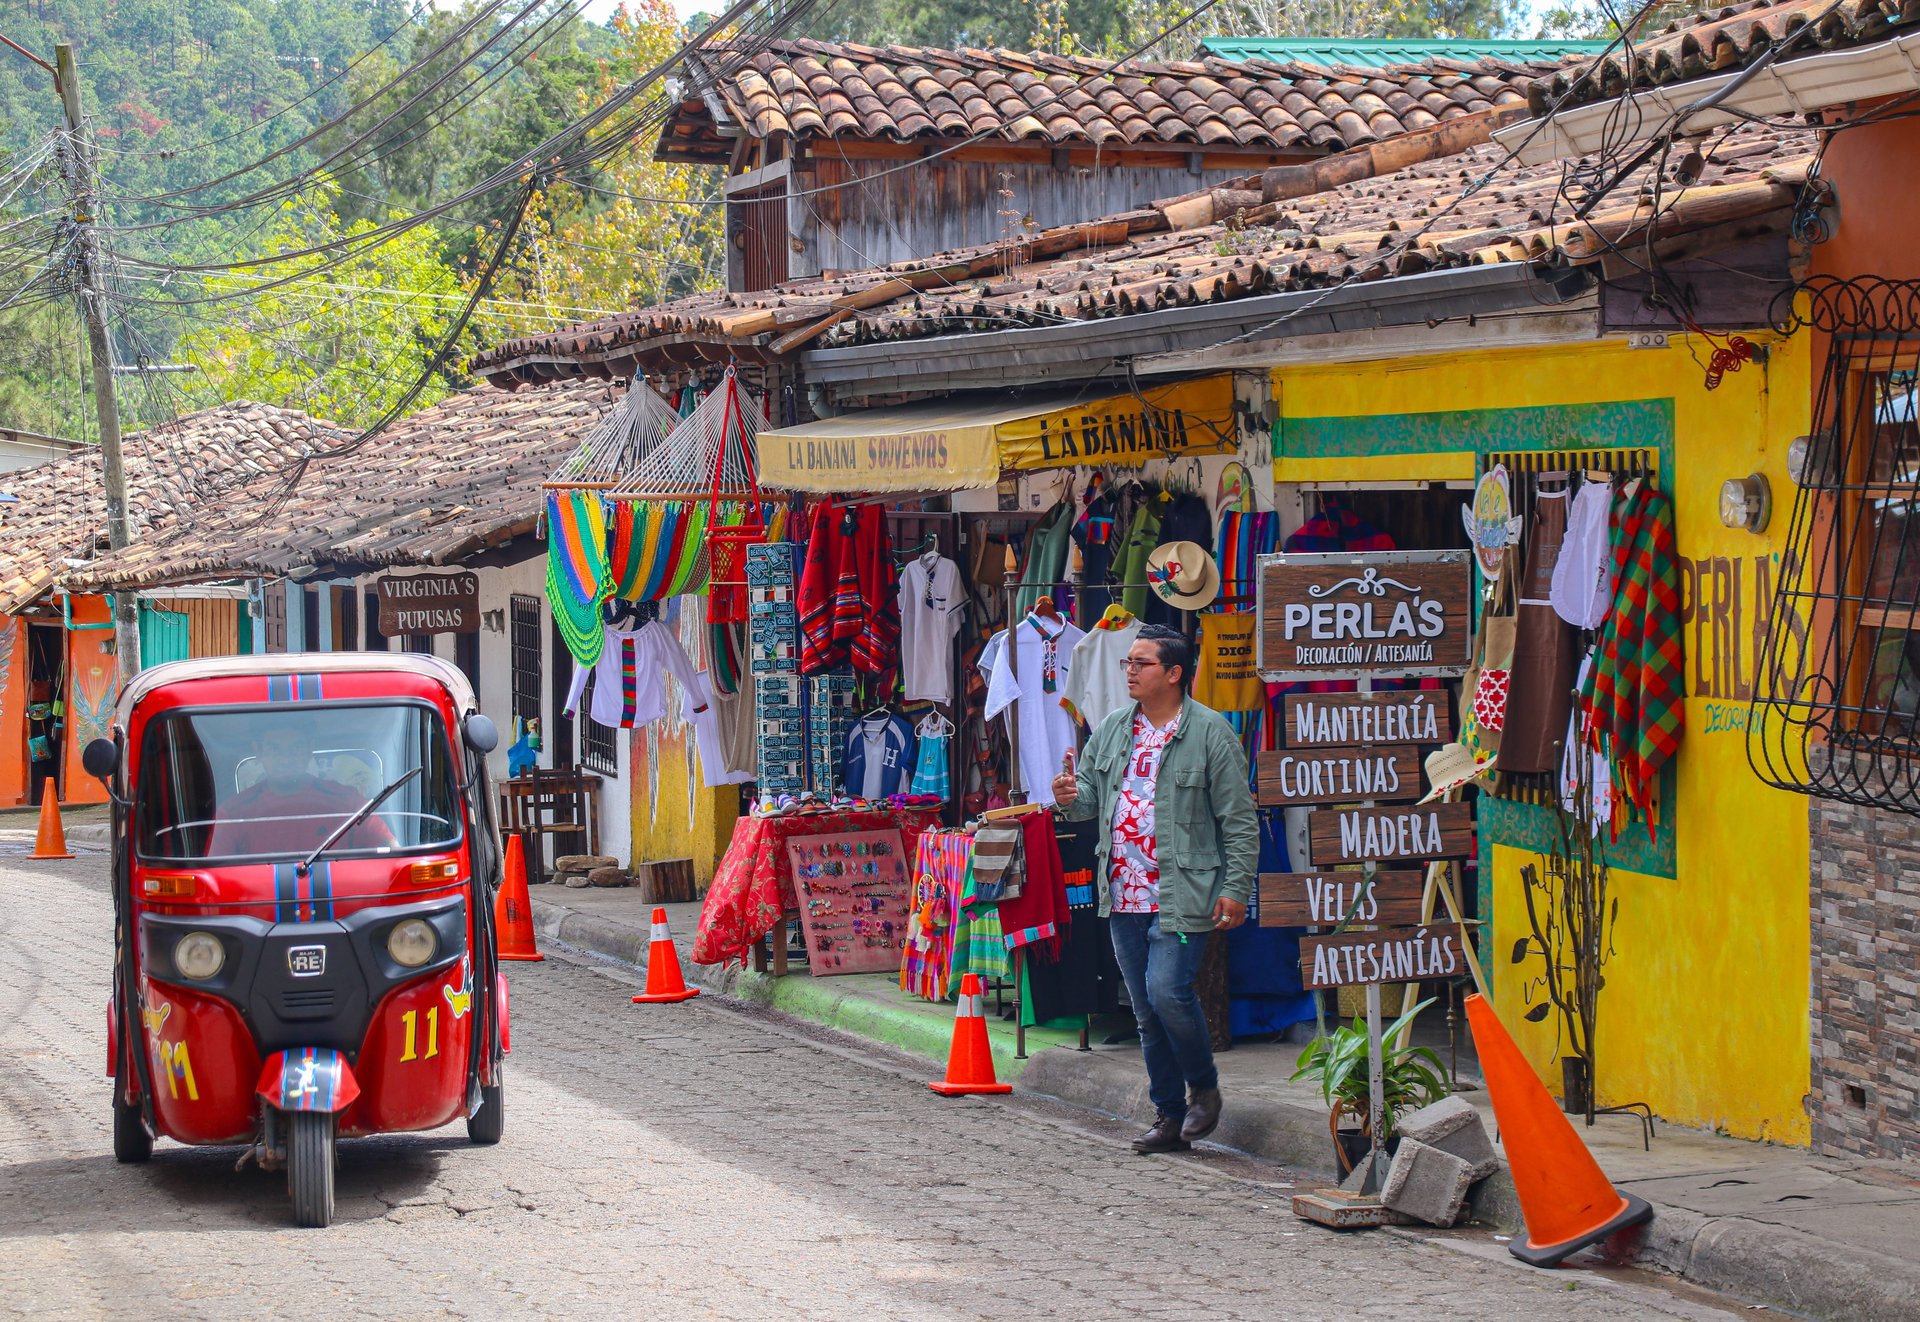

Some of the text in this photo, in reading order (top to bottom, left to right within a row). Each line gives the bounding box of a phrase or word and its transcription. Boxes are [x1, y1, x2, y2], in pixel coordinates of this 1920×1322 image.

[788, 441, 803, 470] LA
[807, 439, 857, 470] BANANA
[1041, 409, 1188, 460] LA BANANA
[397, 608, 462, 630] PUPUSAS
[1284, 595, 1444, 640] PERLA'S
[1217, 646, 1252, 656] DIOS
[1296, 642, 1363, 665] DECORACIÓN
[1375, 640, 1433, 663] ARTESANÍA
[1296, 694, 1438, 743] MANTELERÍA
[882, 747, 899, 768] H
[1280, 756, 1399, 797] CORTINAS
[1340, 811, 1443, 858] MADERA
[1306, 877, 1378, 922] VELAS
[296, 955, 320, 971] RE
[1312, 928, 1456, 985] ARTESANÍAS
[400, 1006, 439, 1063] 11
